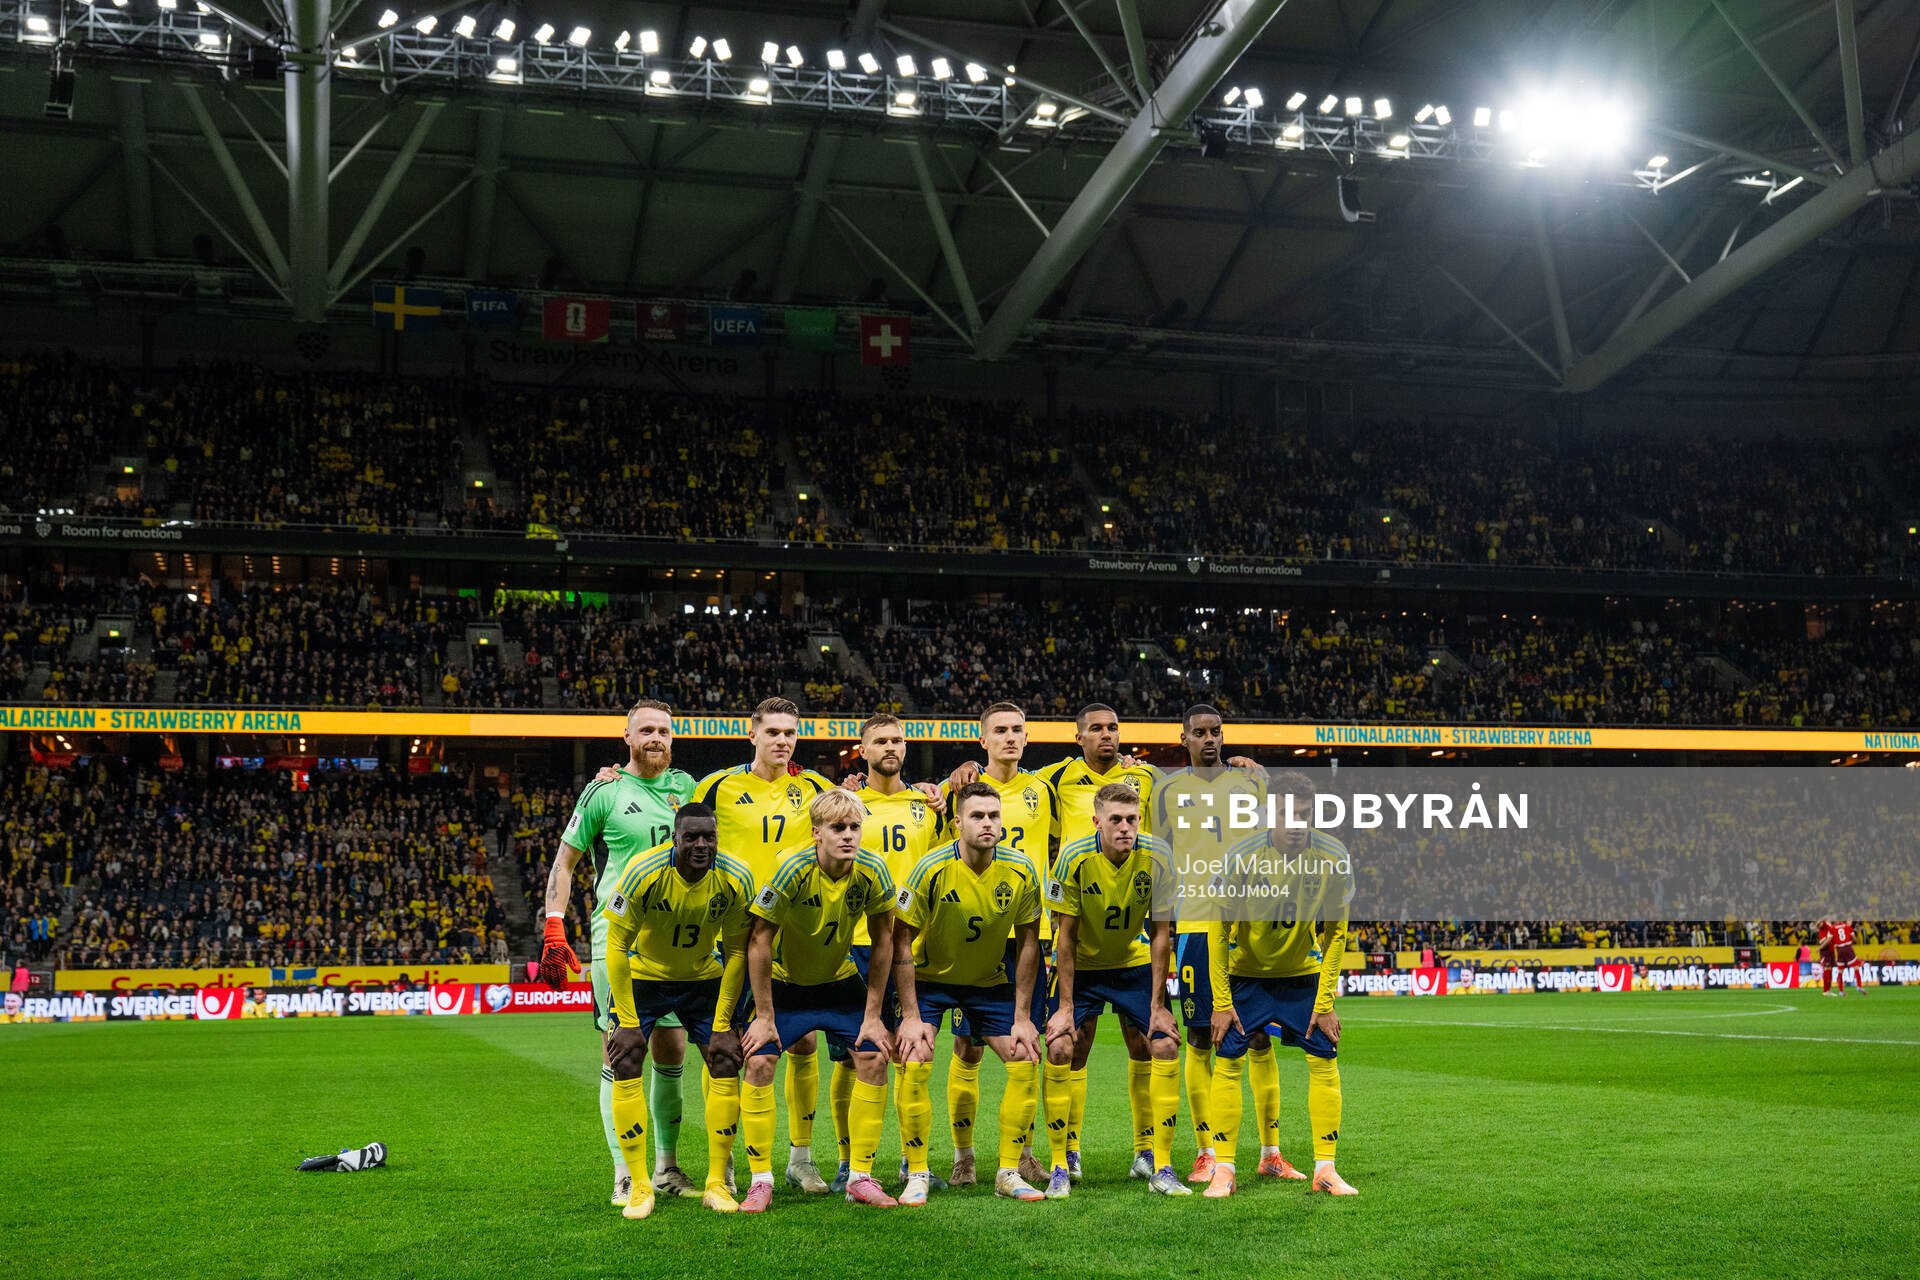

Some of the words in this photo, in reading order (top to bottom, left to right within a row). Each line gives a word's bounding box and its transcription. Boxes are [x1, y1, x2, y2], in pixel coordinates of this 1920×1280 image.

[472, 300, 509, 312] FIFA
[713, 319, 757, 334] UEFA
[489, 340, 649, 373] Strawberry
[661, 352, 738, 375] Arena
[62, 526, 99, 537] Room
[102, 527, 119, 538] for
[122, 527, 183, 540] emotions
[1088, 558, 1146, 573] Strawberry
[1147, 560, 1178, 572] Arena
[1209, 562, 1238, 574] Room
[1239, 563, 1254, 575] for
[1255, 565, 1302, 576] emotions
[0, 710, 95, 728] ALARENAN
[111, 711, 236, 730] STRAWBERRY
[242, 712, 300, 731] ARENA
[671, 718, 815, 737] NATIONALAN
[828, 719, 935, 738] STRRRY
[939, 722, 981, 739] AREN
[1315, 727, 1441, 743] NATIONALARENAN
[1452, 729, 1544, 745] STRAWBERRY
[1550, 730, 1592, 745] ARENA
[1865, 735, 1920, 749] NATIONA
[650, 826, 671, 847] 12
[762, 814, 786, 844] 17
[882, 824, 906, 852] 16
[1104, 906, 1131, 930] 21
[1271, 902, 1298, 929] 18
[672, 923, 701, 948] 13
[824, 922, 839, 946] 7
[966, 916, 983, 942] 5
[1838, 928, 1846, 941] 8
[1182, 965, 1195, 993] 9
[1475, 968, 1534, 989] FRAMÅT
[1648, 965, 1705, 986] FRAMÅT
[24, 993, 107, 1018] FRAMÅT
[110, 995, 197, 1017] SVERIGE!
[266, 988, 345, 1013] FRAMÅT
[349, 991, 430, 1011] SVERIGE!
[515, 990, 592, 1005] EUROPEAN
